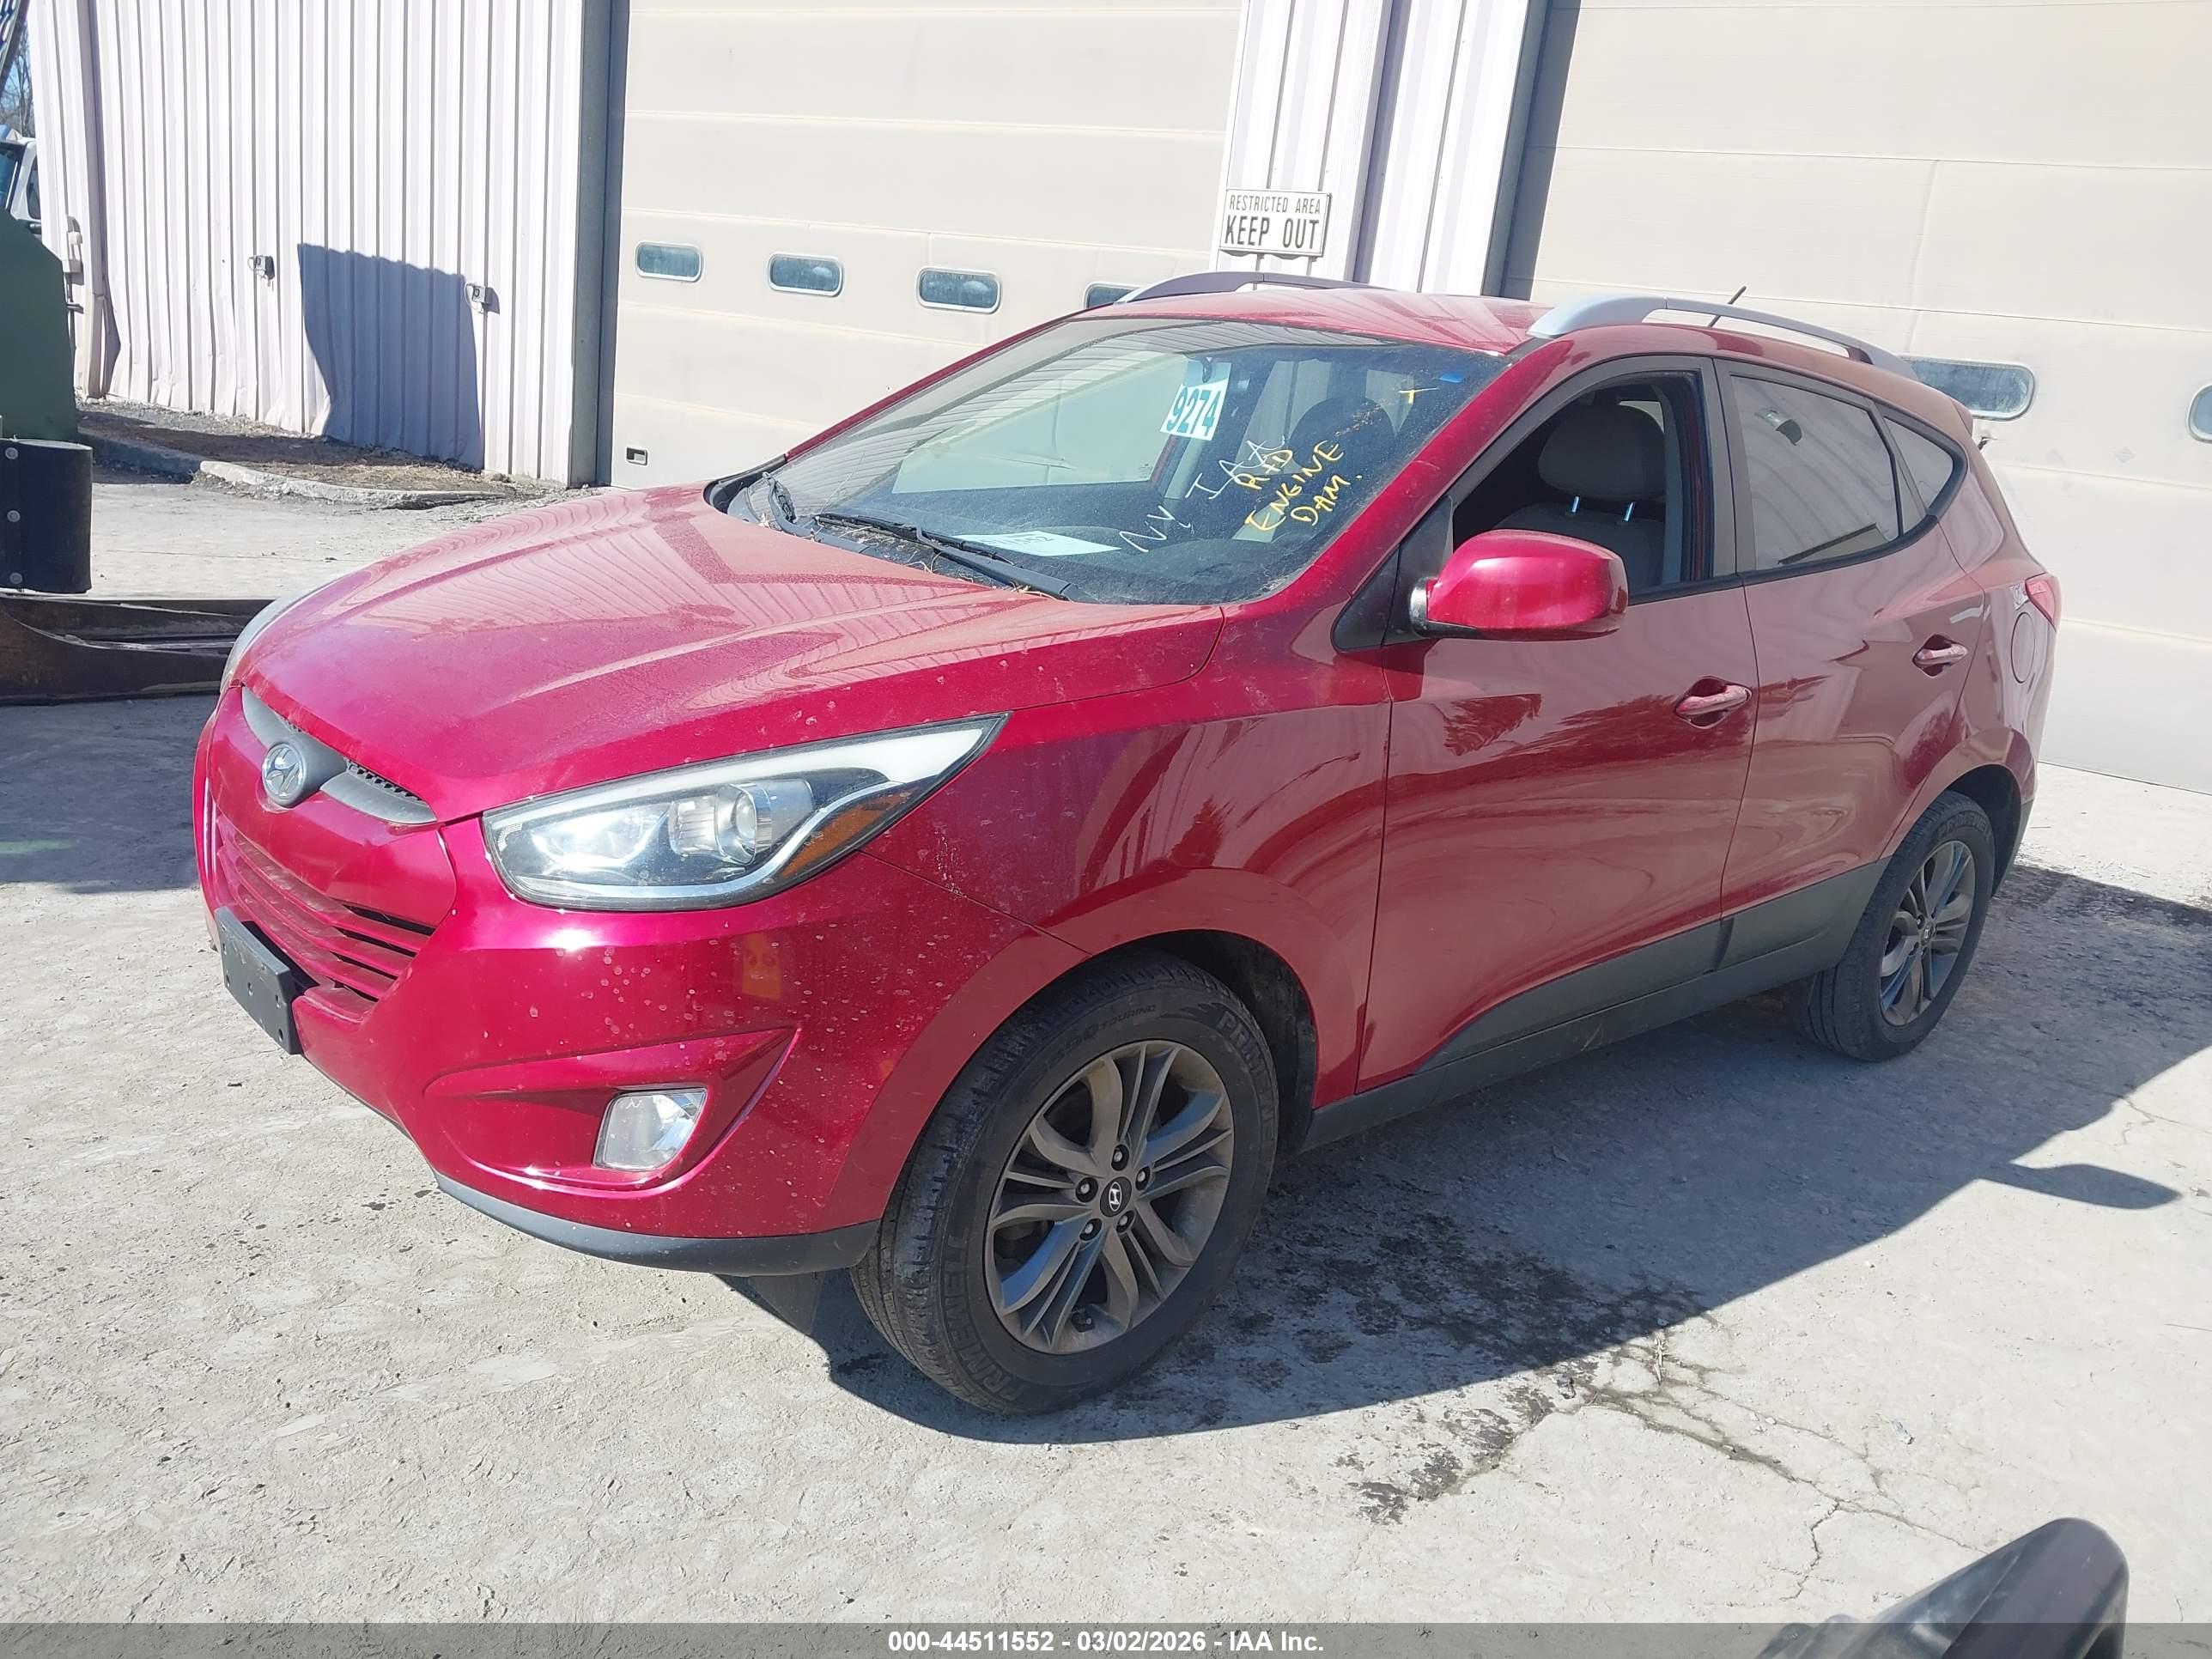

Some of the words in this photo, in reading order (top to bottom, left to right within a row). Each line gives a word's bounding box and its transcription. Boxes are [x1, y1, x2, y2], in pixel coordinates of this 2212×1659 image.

[1229, 194, 1289, 213] RESTRICTED
[1295, 198, 1321, 214] AREA
[1224, 215, 1270, 246] KEEP
[1283, 218, 1320, 249] OUT
[1166, 387, 1222, 437] 9274
[1244, 440, 1345, 531] ENGINE
[1100, 1004, 1157, 1029] TOURING
